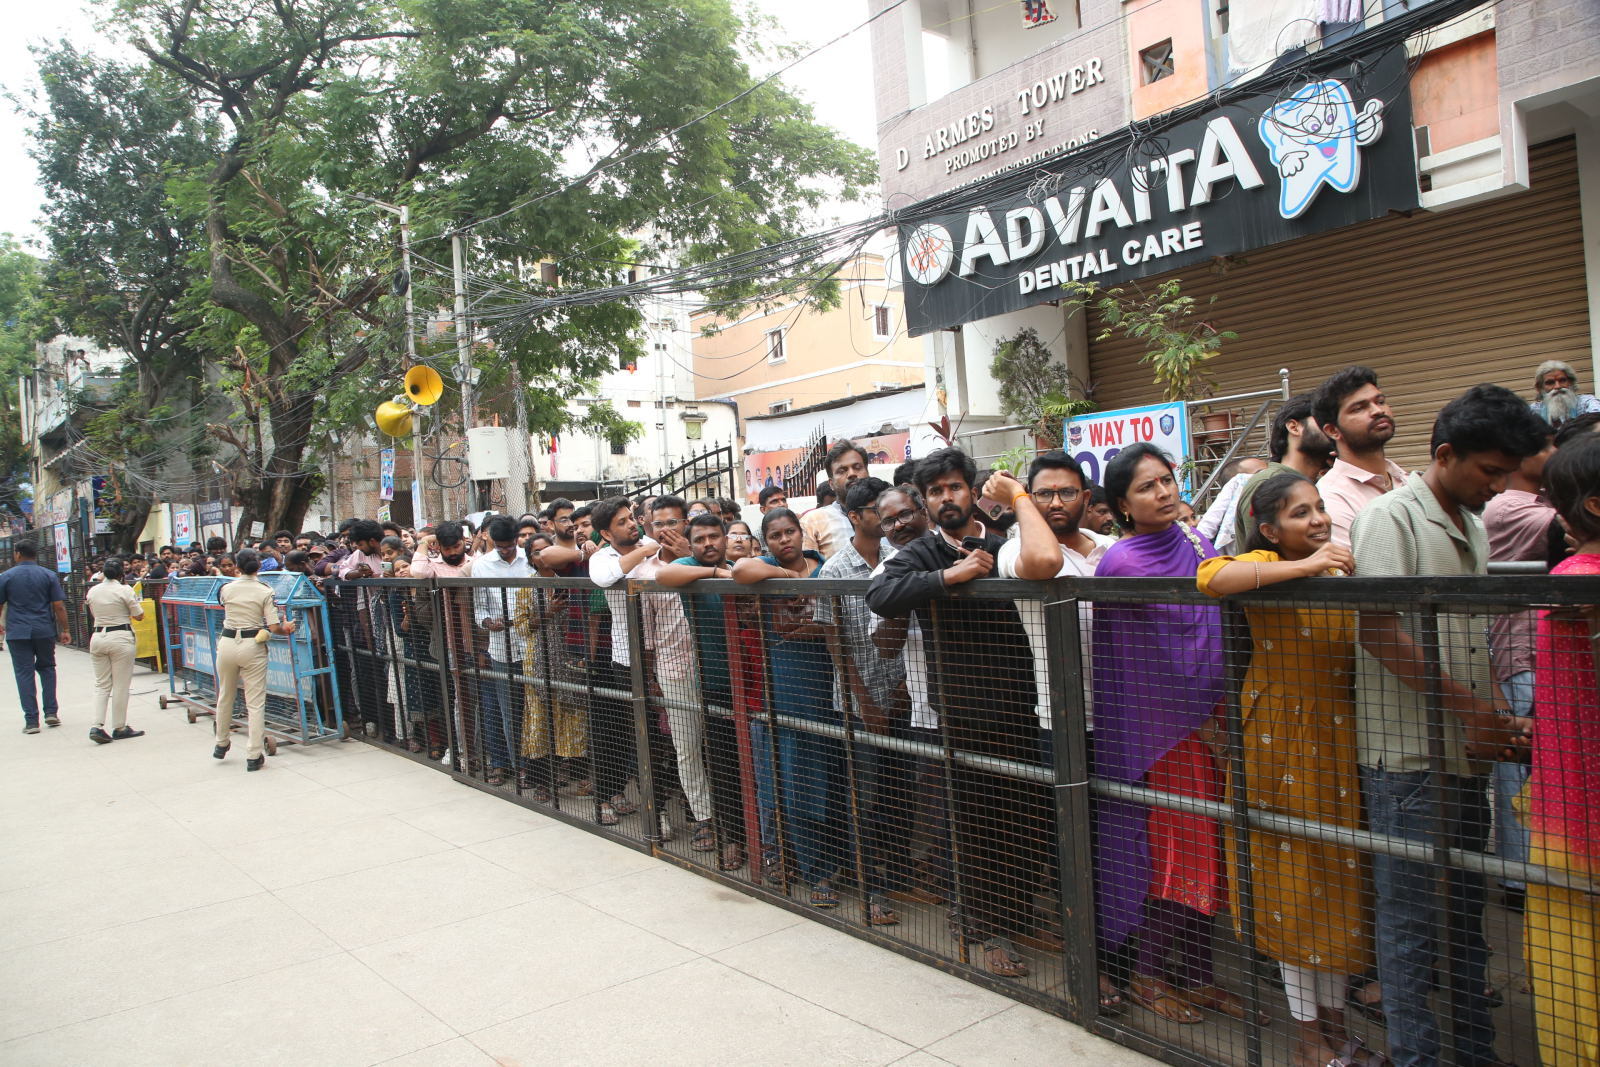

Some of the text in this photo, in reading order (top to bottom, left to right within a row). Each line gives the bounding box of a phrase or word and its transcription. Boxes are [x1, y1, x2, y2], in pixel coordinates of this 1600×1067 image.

[922, 104, 994, 159] ARMES
[1016, 56, 1105, 116] TOWER
[945, 118, 1046, 175] PROMOTED BY
[958, 115, 1264, 278] ADVAITA
[1018, 221, 1204, 296] DENTAL CARE
[1088, 415, 1154, 448] WAY TO
